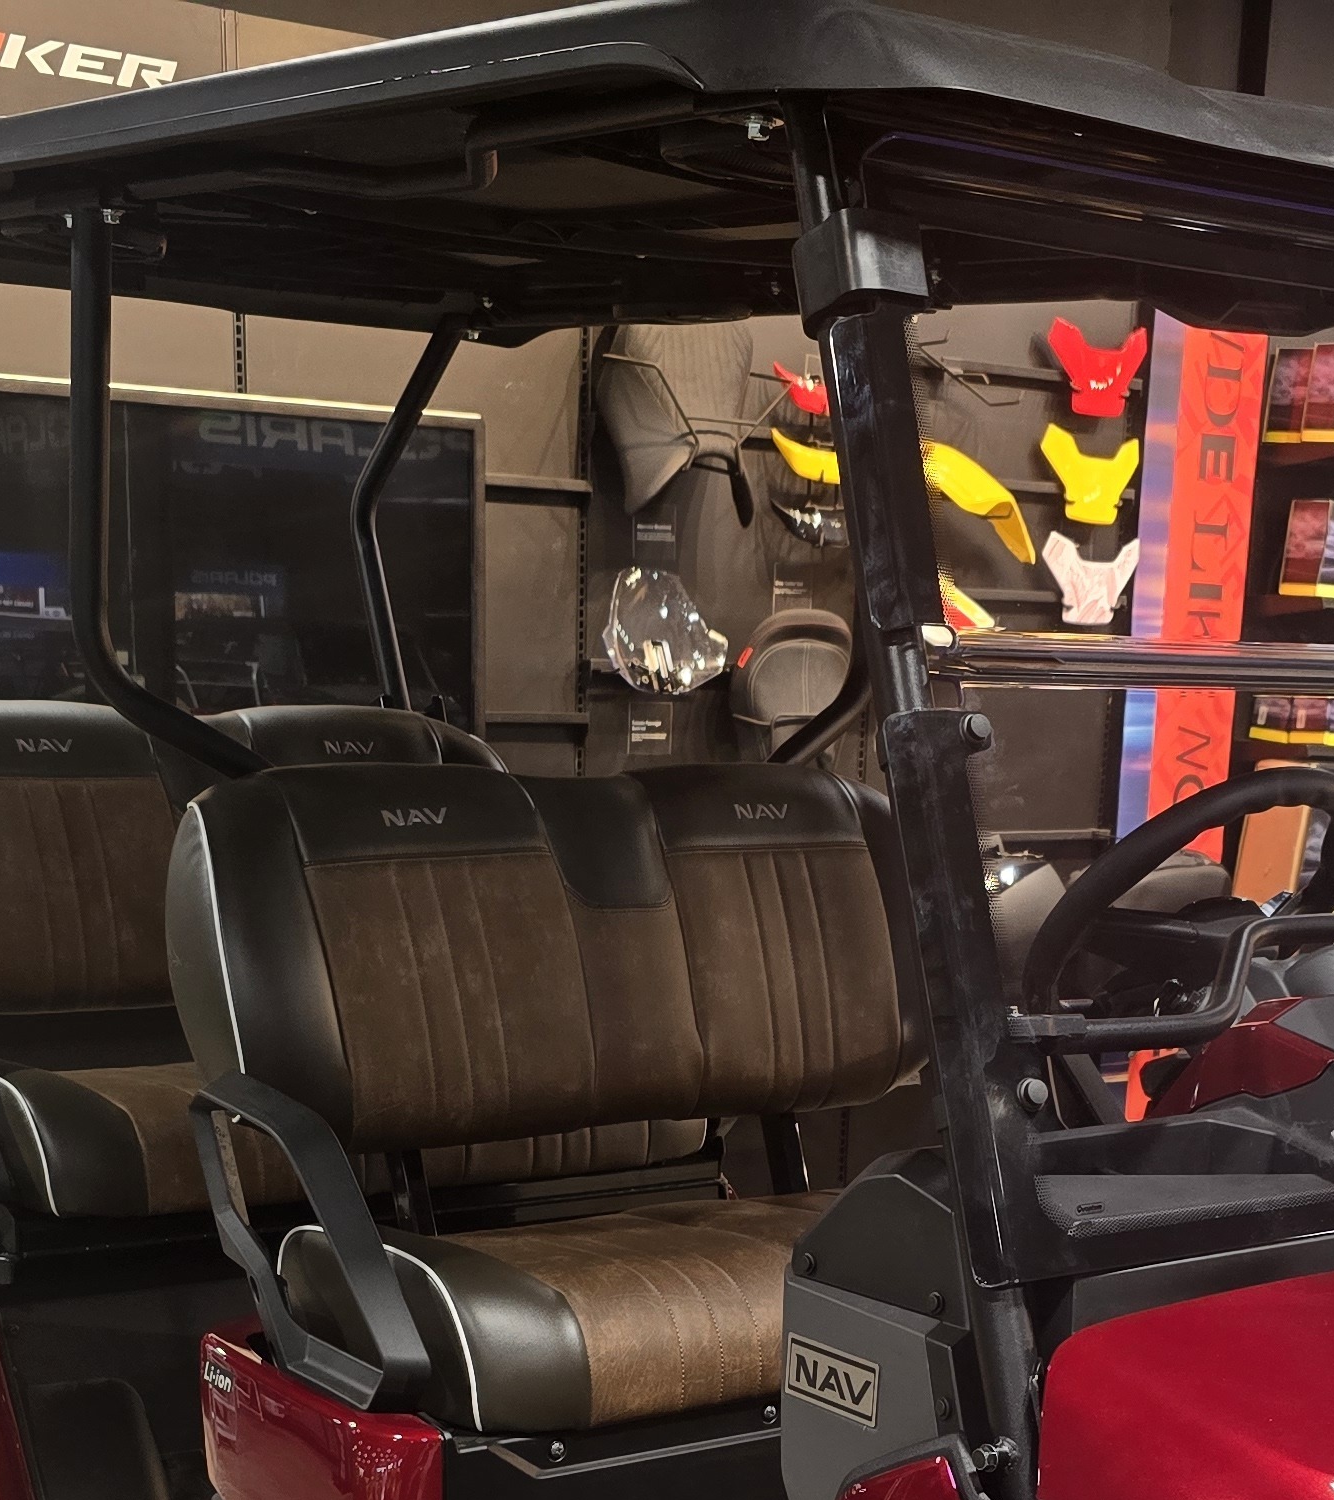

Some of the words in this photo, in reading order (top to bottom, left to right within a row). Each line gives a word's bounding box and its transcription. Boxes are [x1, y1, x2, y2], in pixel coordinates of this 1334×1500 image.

[15, 737, 73, 754] NAV
[323, 740, 375, 756] NAV
[380, 806, 447, 827] NAV
[734, 803, 789, 820] NAV
[203, 1361, 232, 1393] Li-ion
[795, 1352, 872, 1406] NAV
